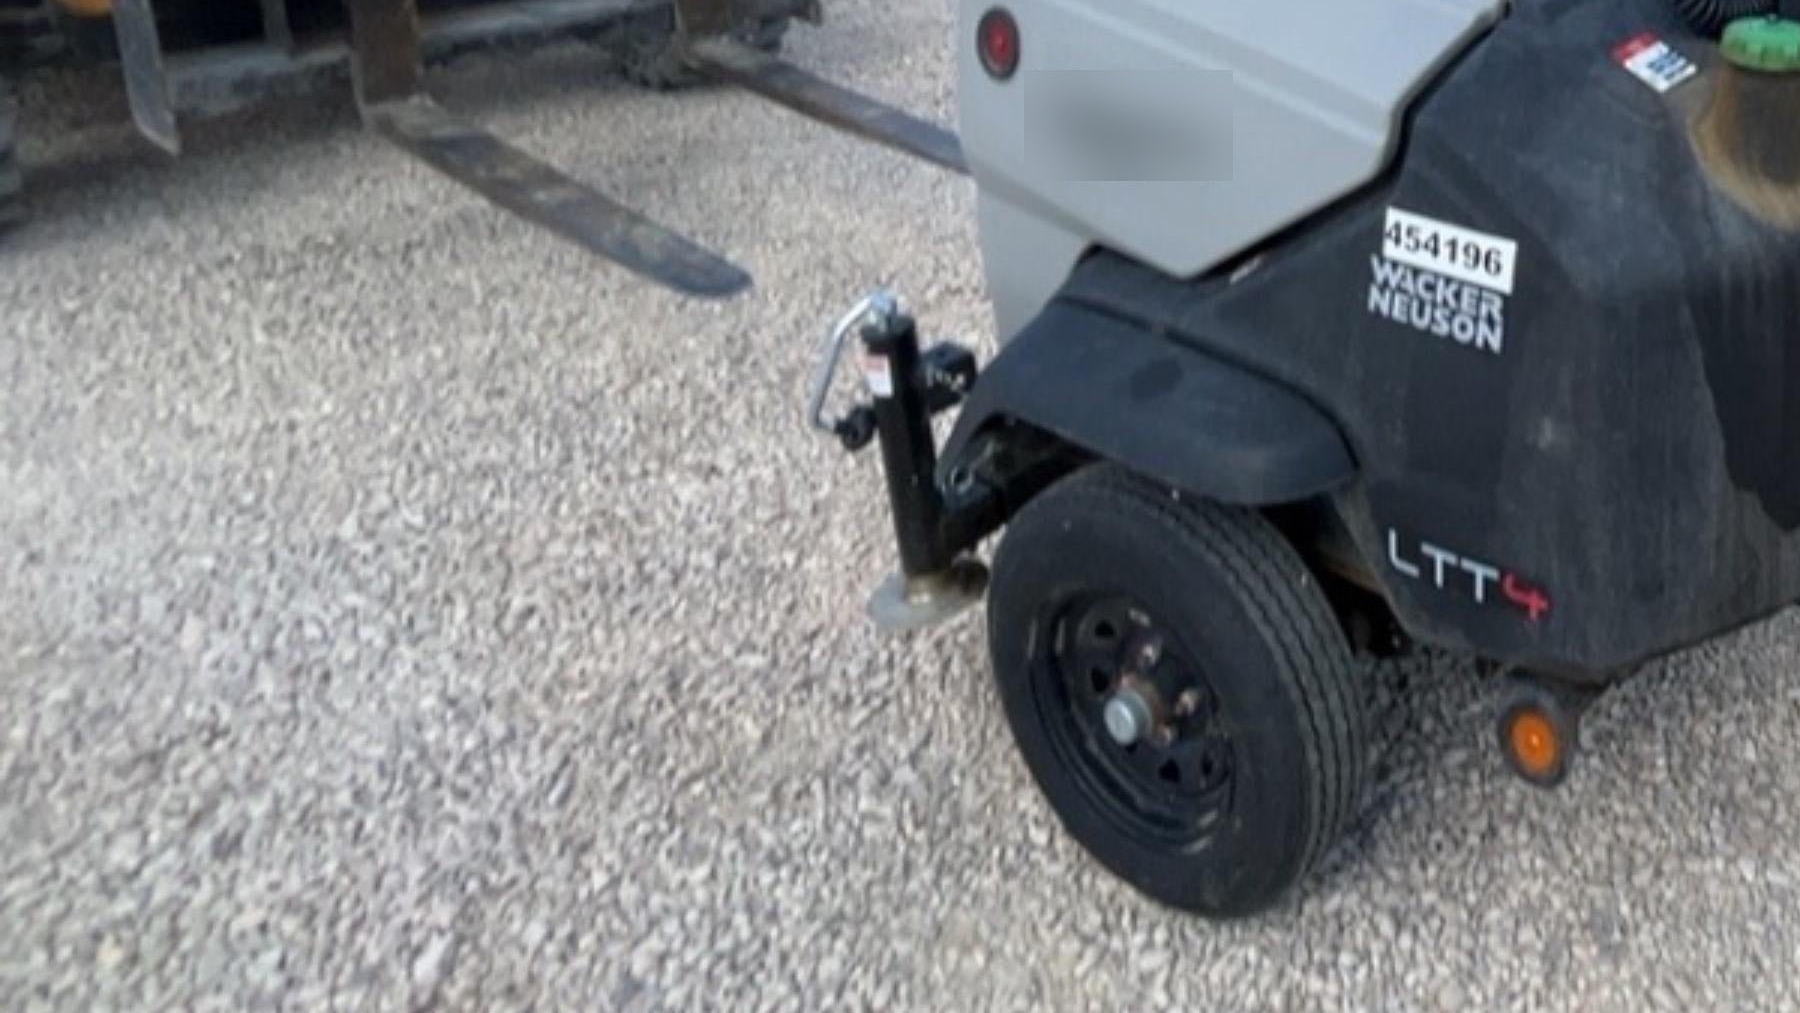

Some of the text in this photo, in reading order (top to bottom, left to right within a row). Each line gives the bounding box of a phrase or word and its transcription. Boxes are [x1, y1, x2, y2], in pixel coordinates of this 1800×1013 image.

[1386, 219, 1502, 276] 454196
[1367, 283, 1504, 355] NEUSON
[1371, 252, 1503, 319] WACKER
[1388, 527, 1549, 621] LTT4
